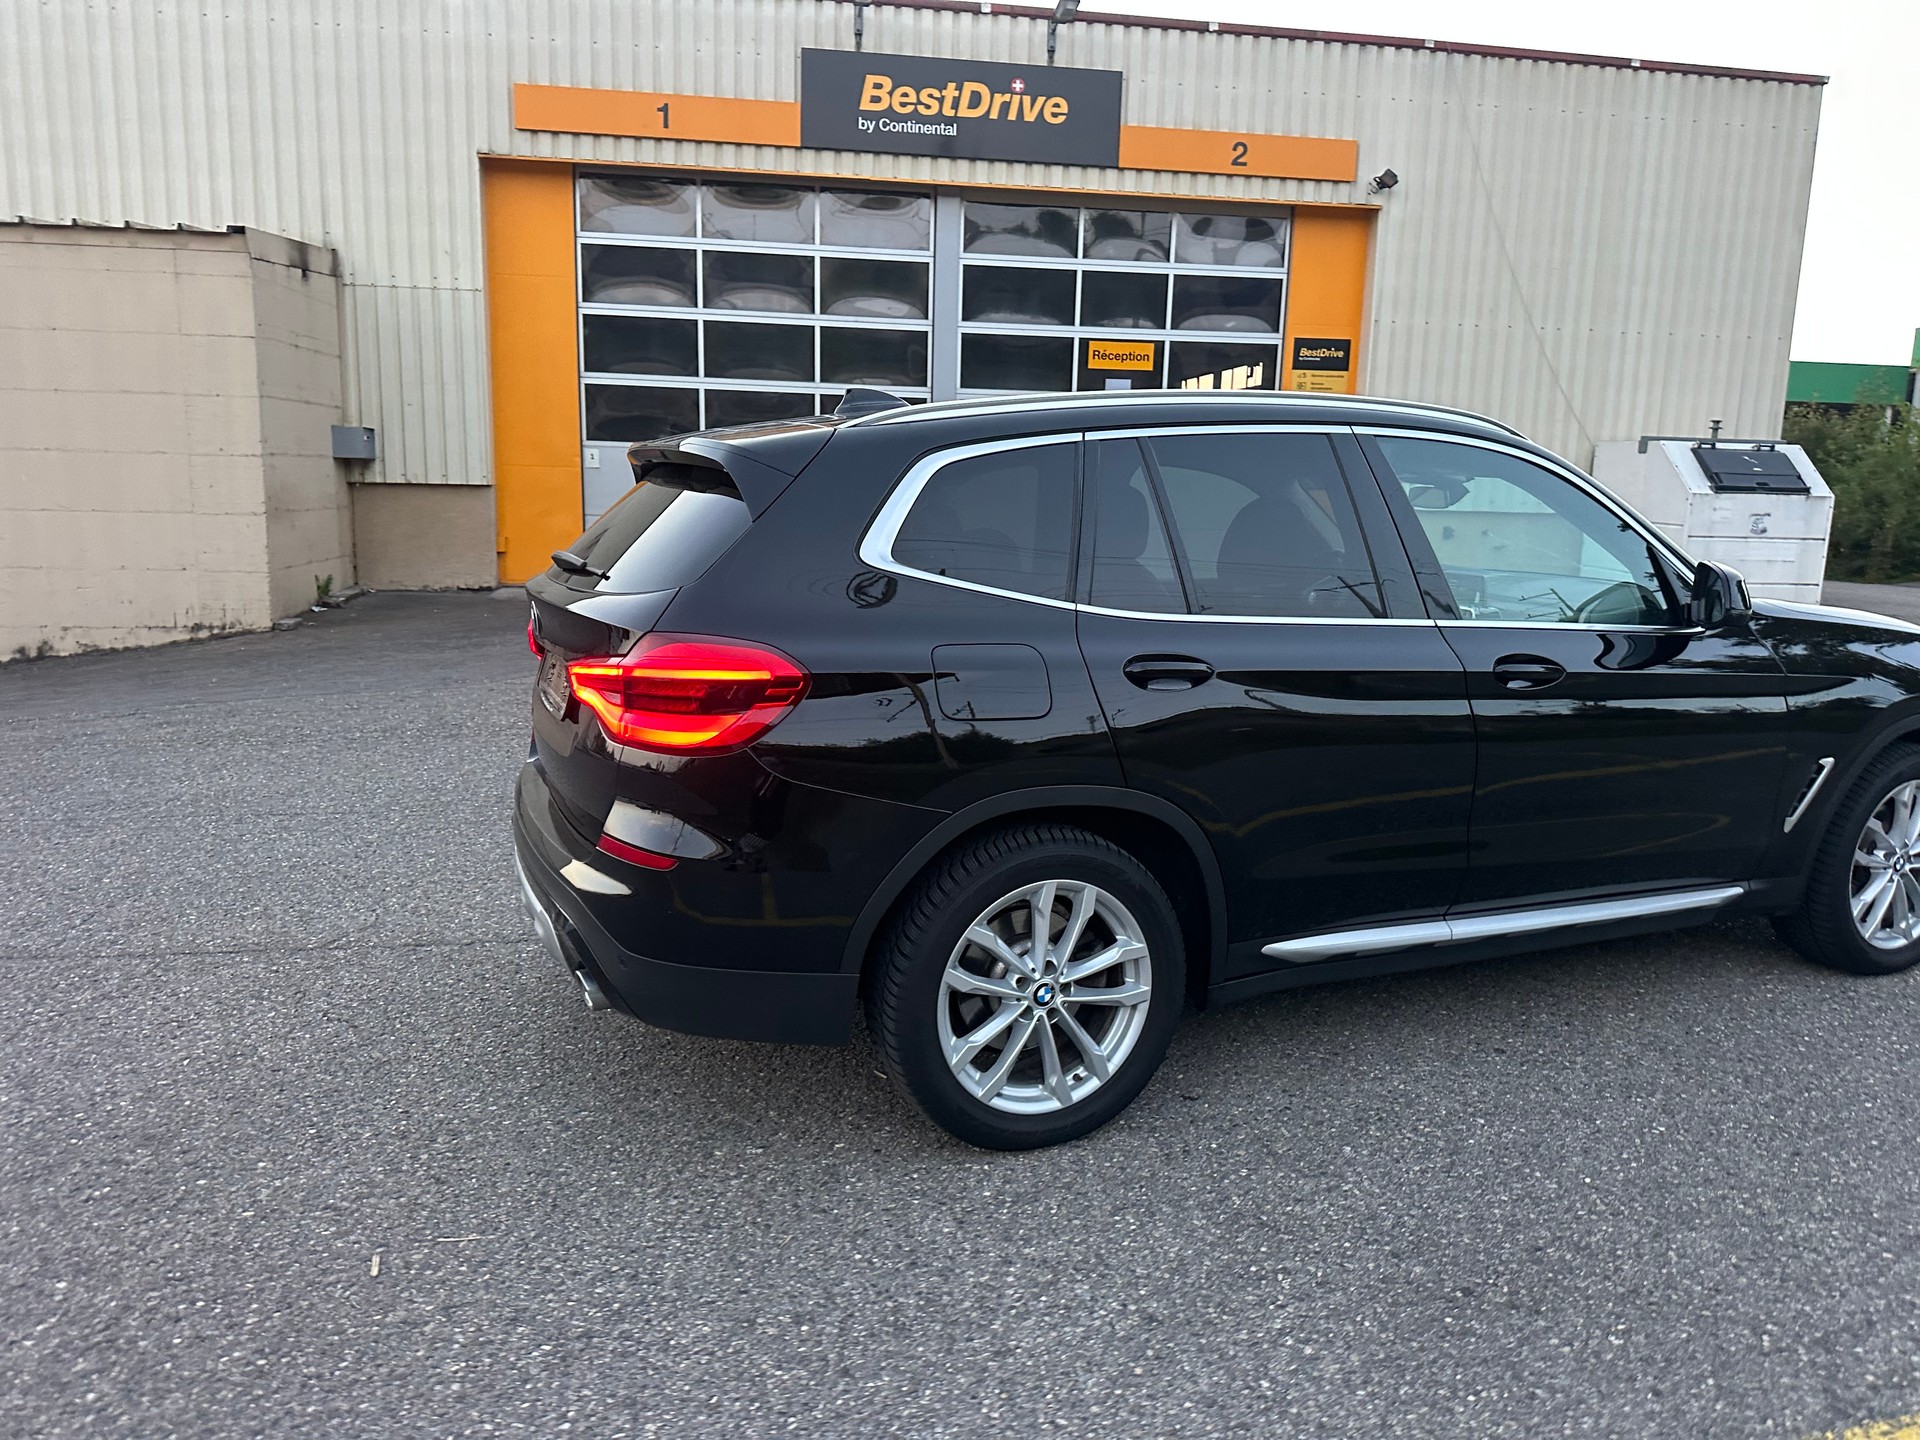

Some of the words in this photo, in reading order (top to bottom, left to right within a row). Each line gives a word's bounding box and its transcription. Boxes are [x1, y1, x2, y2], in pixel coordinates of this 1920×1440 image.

[859, 74, 1069, 124] BestDrive
[656, 102, 669, 129] 1
[858, 117, 876, 134] by
[878, 117, 957, 136] Continental
[1230, 141, 1248, 167] 2
[1092, 349, 1150, 364] Réception
[1299, 347, 1345, 358] BestDrive
